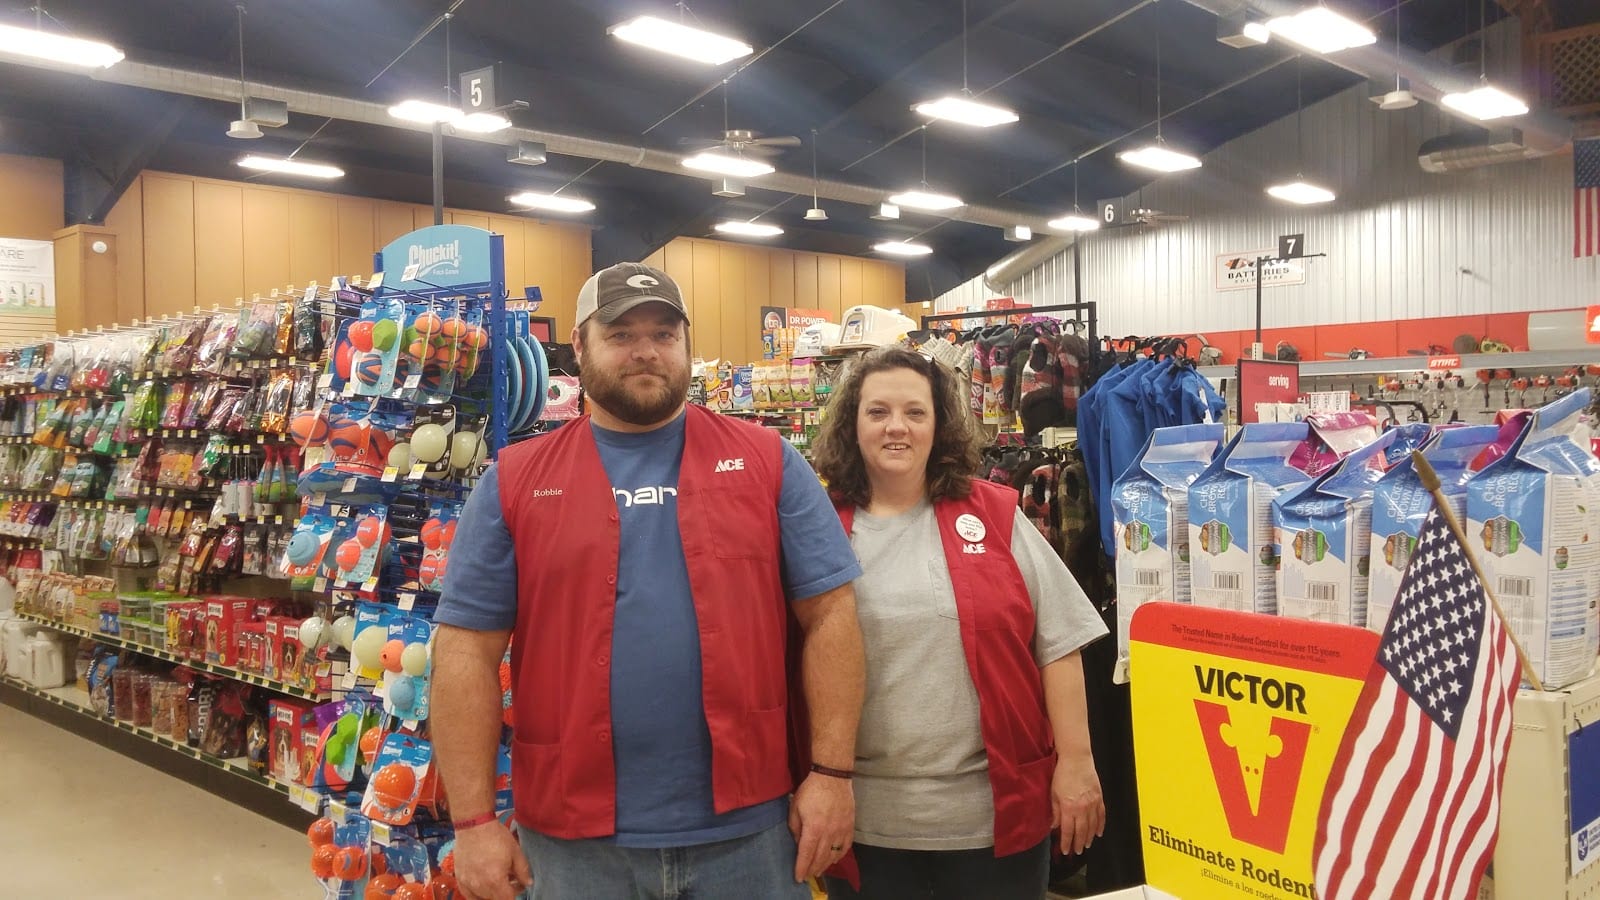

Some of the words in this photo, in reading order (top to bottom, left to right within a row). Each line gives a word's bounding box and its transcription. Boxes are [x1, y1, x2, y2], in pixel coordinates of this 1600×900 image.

[471, 78, 482, 107] 5
[1104, 204, 1114, 222] 6
[1286, 239, 1296, 254] 7
[408, 240, 459, 272] Chuckit!
[1228, 267, 1289, 279] BATTRIES
[1268, 374, 1290, 389] serving
[714, 458, 744, 473] ACE
[533, 487, 563, 498] Robbie
[963, 543, 986, 554] ACE
[1183, 625, 1205, 637] Trusted
[1206, 628, 1224, 640] Name
[1232, 632, 1254, 645] Rodent
[1255, 636, 1279, 648] Control
[1280, 640, 1289, 650] for
[1290, 644, 1306, 652] over
[1307, 645, 1319, 654] 115
[1194, 665, 1307, 714] VICTOR
[1149, 825, 1236, 872] Eliminate
[1242, 884, 1254, 895] los
